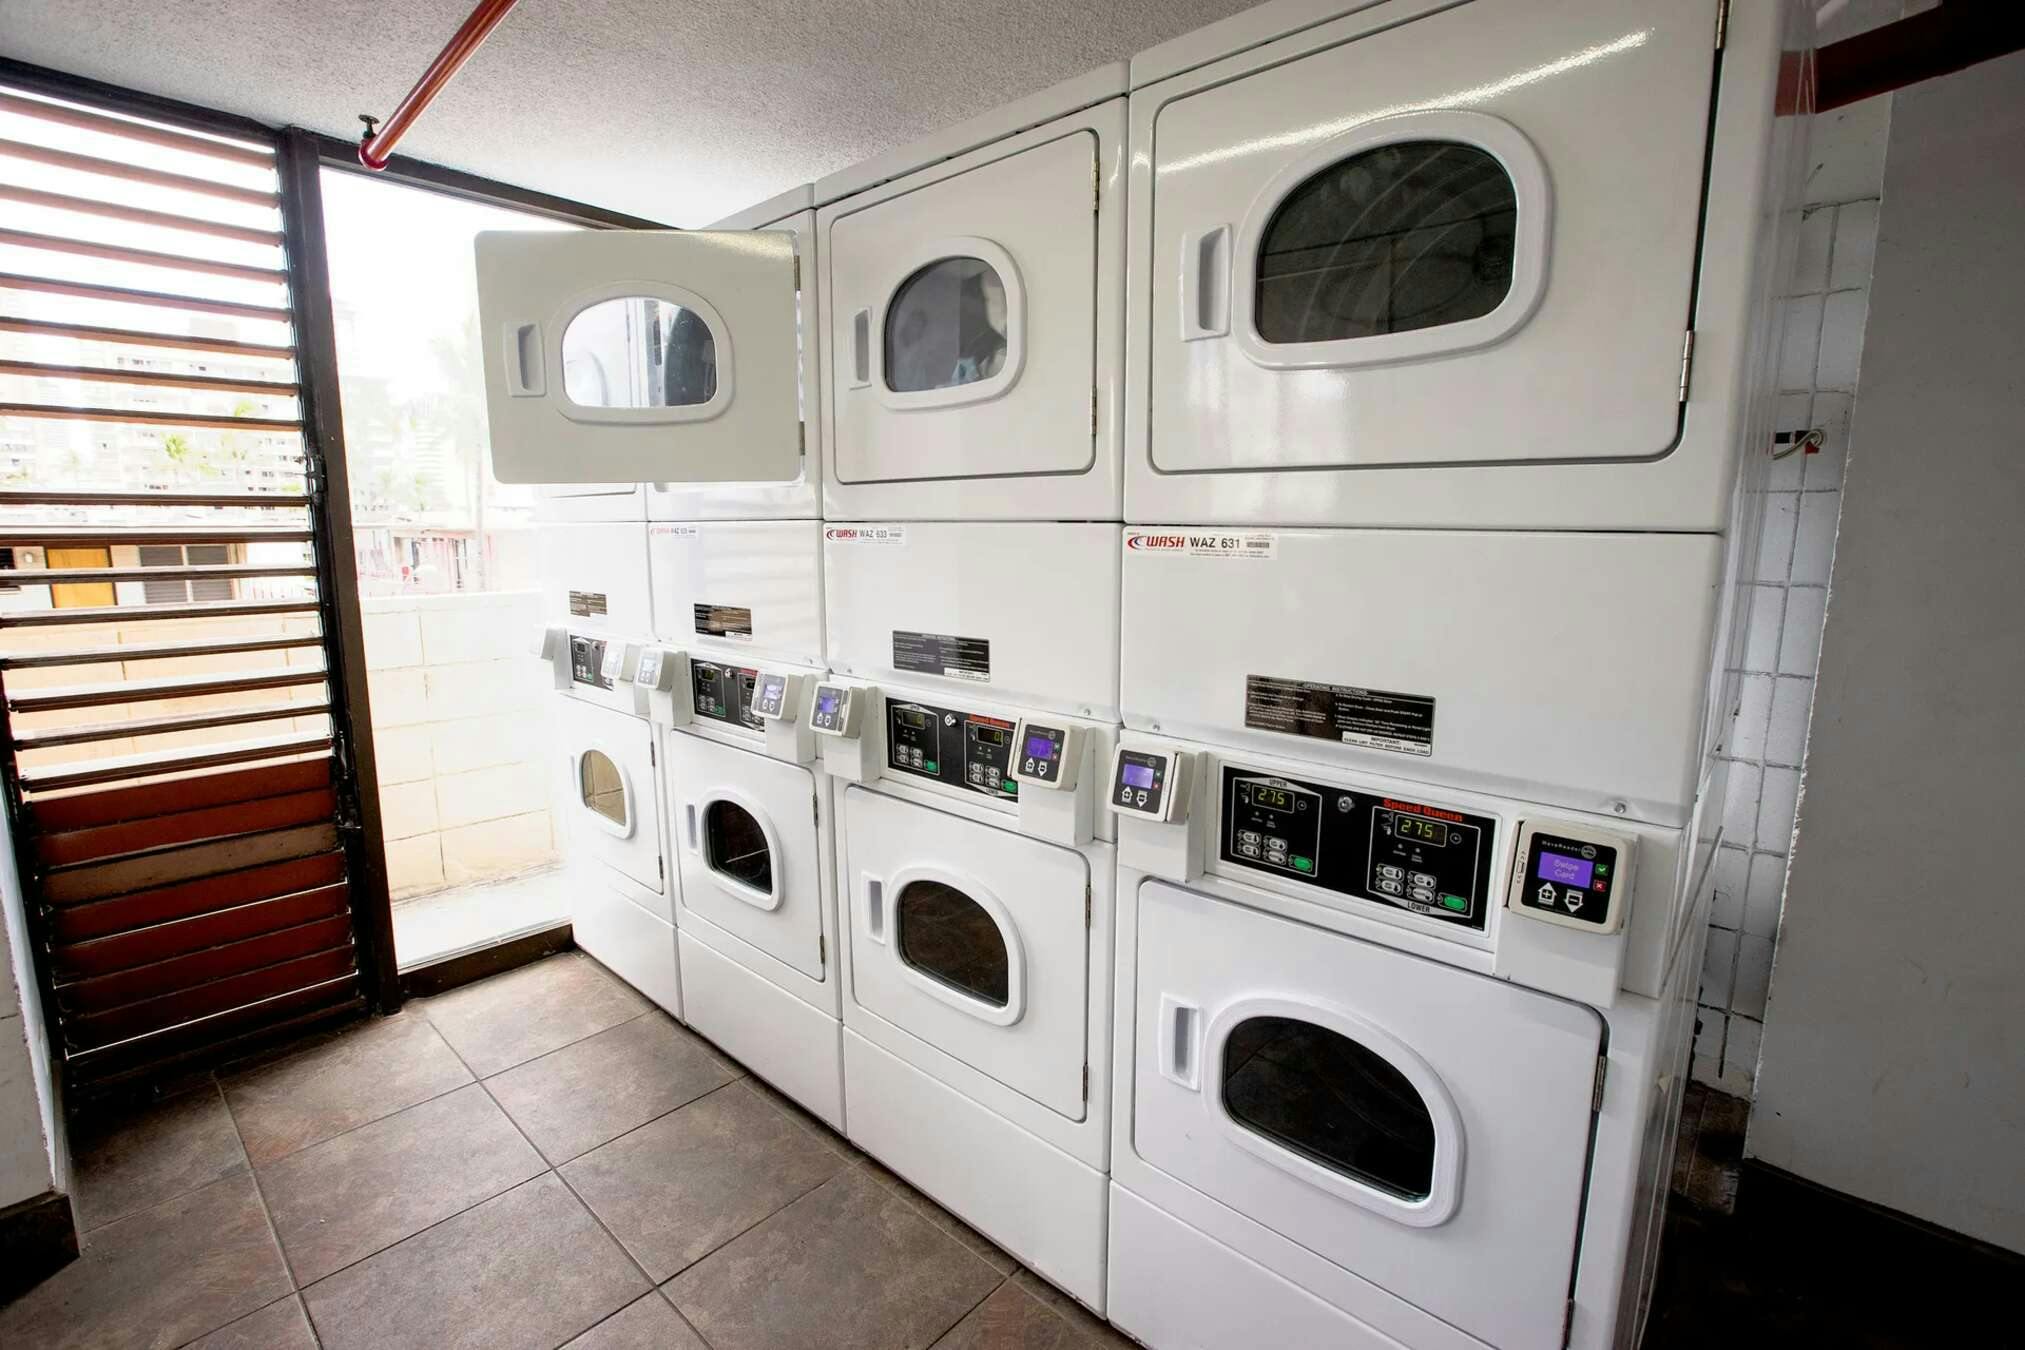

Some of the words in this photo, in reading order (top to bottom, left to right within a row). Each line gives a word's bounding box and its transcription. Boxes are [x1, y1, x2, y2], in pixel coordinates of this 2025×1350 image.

[836, 529, 857, 538] WASH
[860, 529, 874, 538] WAZ
[1146, 536, 1185, 548] WASH
[1190, 537, 1216, 548] WAZ
[1221, 537, 1240, 549] 631
[1269, 778, 1288, 788] UPPER
[1257, 788, 1286, 805] 275
[1383, 799, 1421, 813] Speed
[1423, 805, 1463, 822] Queen
[1401, 820, 1433, 838] 275
[1407, 901, 1431, 913] LOWER
